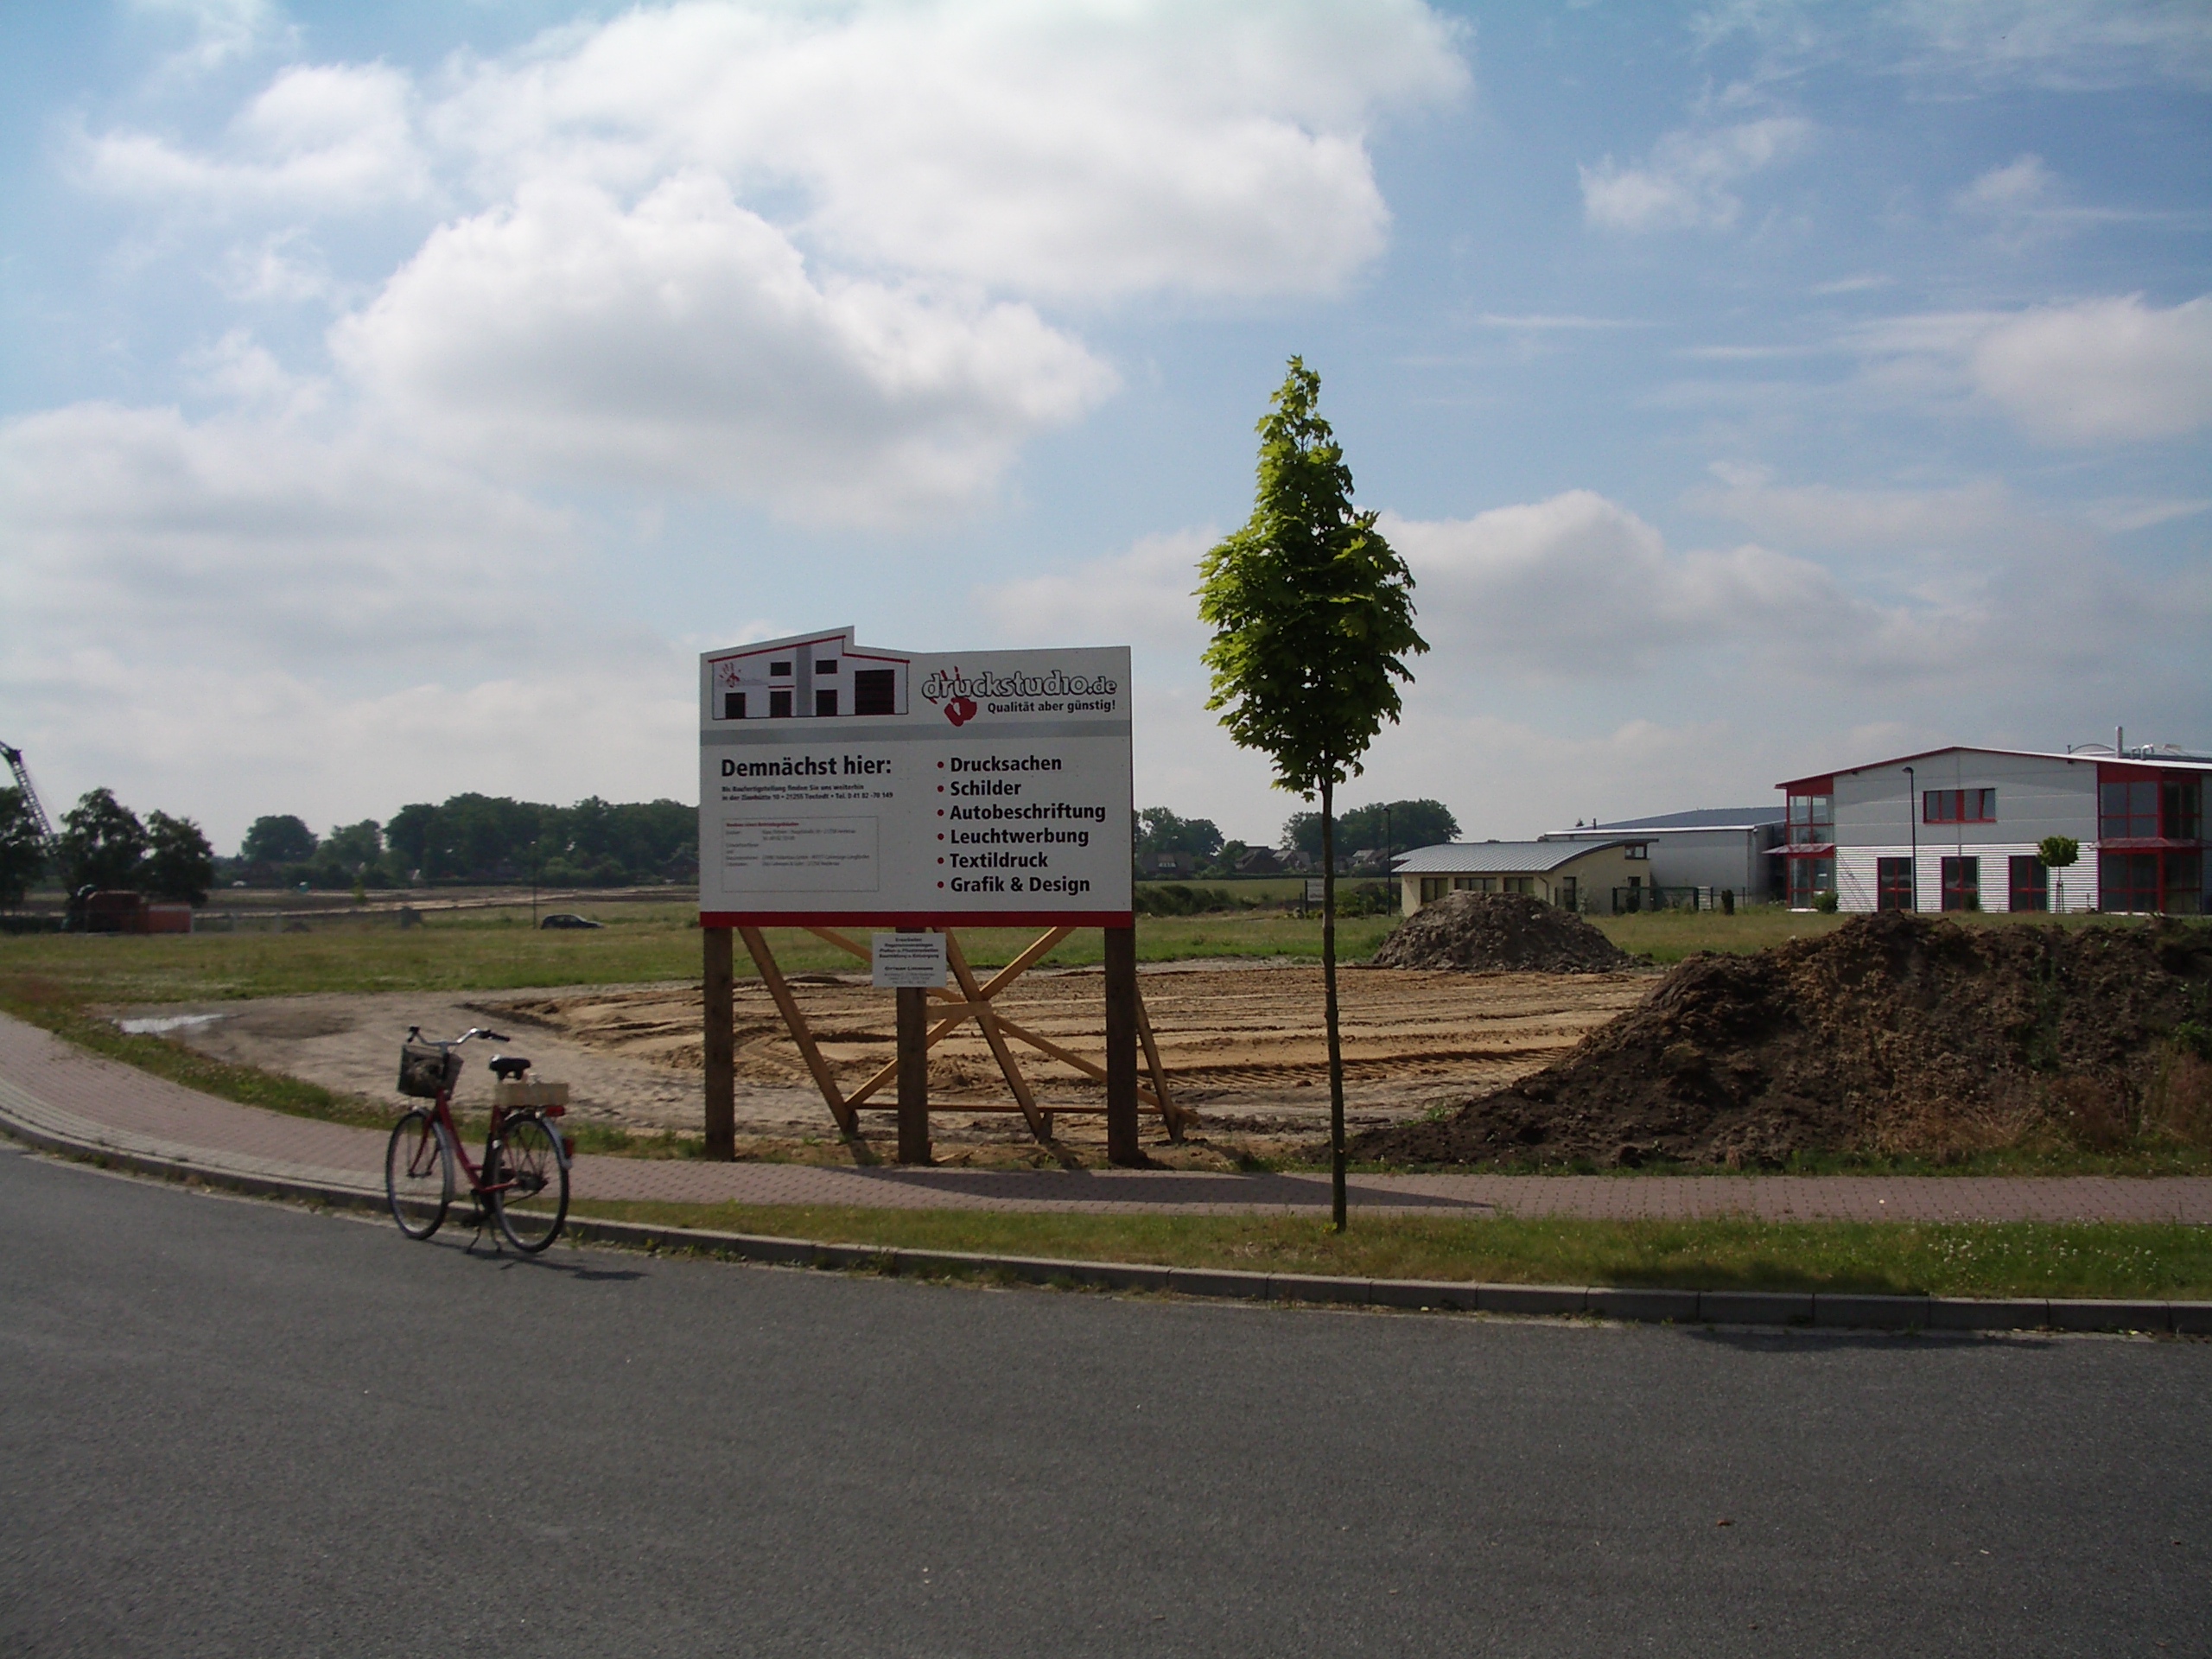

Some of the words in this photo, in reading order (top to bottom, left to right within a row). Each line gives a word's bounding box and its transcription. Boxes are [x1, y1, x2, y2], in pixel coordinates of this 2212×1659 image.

[921, 669, 1117, 698] druckstudio.de
[988, 701, 1034, 714] Qualität
[1039, 701, 1064, 711] aber
[1068, 699, 1116, 714] günstig!
[721, 756, 837, 777] Demnächst
[844, 755, 892, 775] hier:
[950, 755, 1061, 772] Drucksachen
[950, 779, 1021, 796] Schilder
[950, 803, 1106, 823] Autobeschriftung
[950, 827, 1090, 847] Leuchtwerbung
[950, 851, 1048, 868] Textildruck
[951, 875, 1004, 893] Grafik
[1010, 876, 1023, 892] &
[1029, 876, 1090, 896] Design
